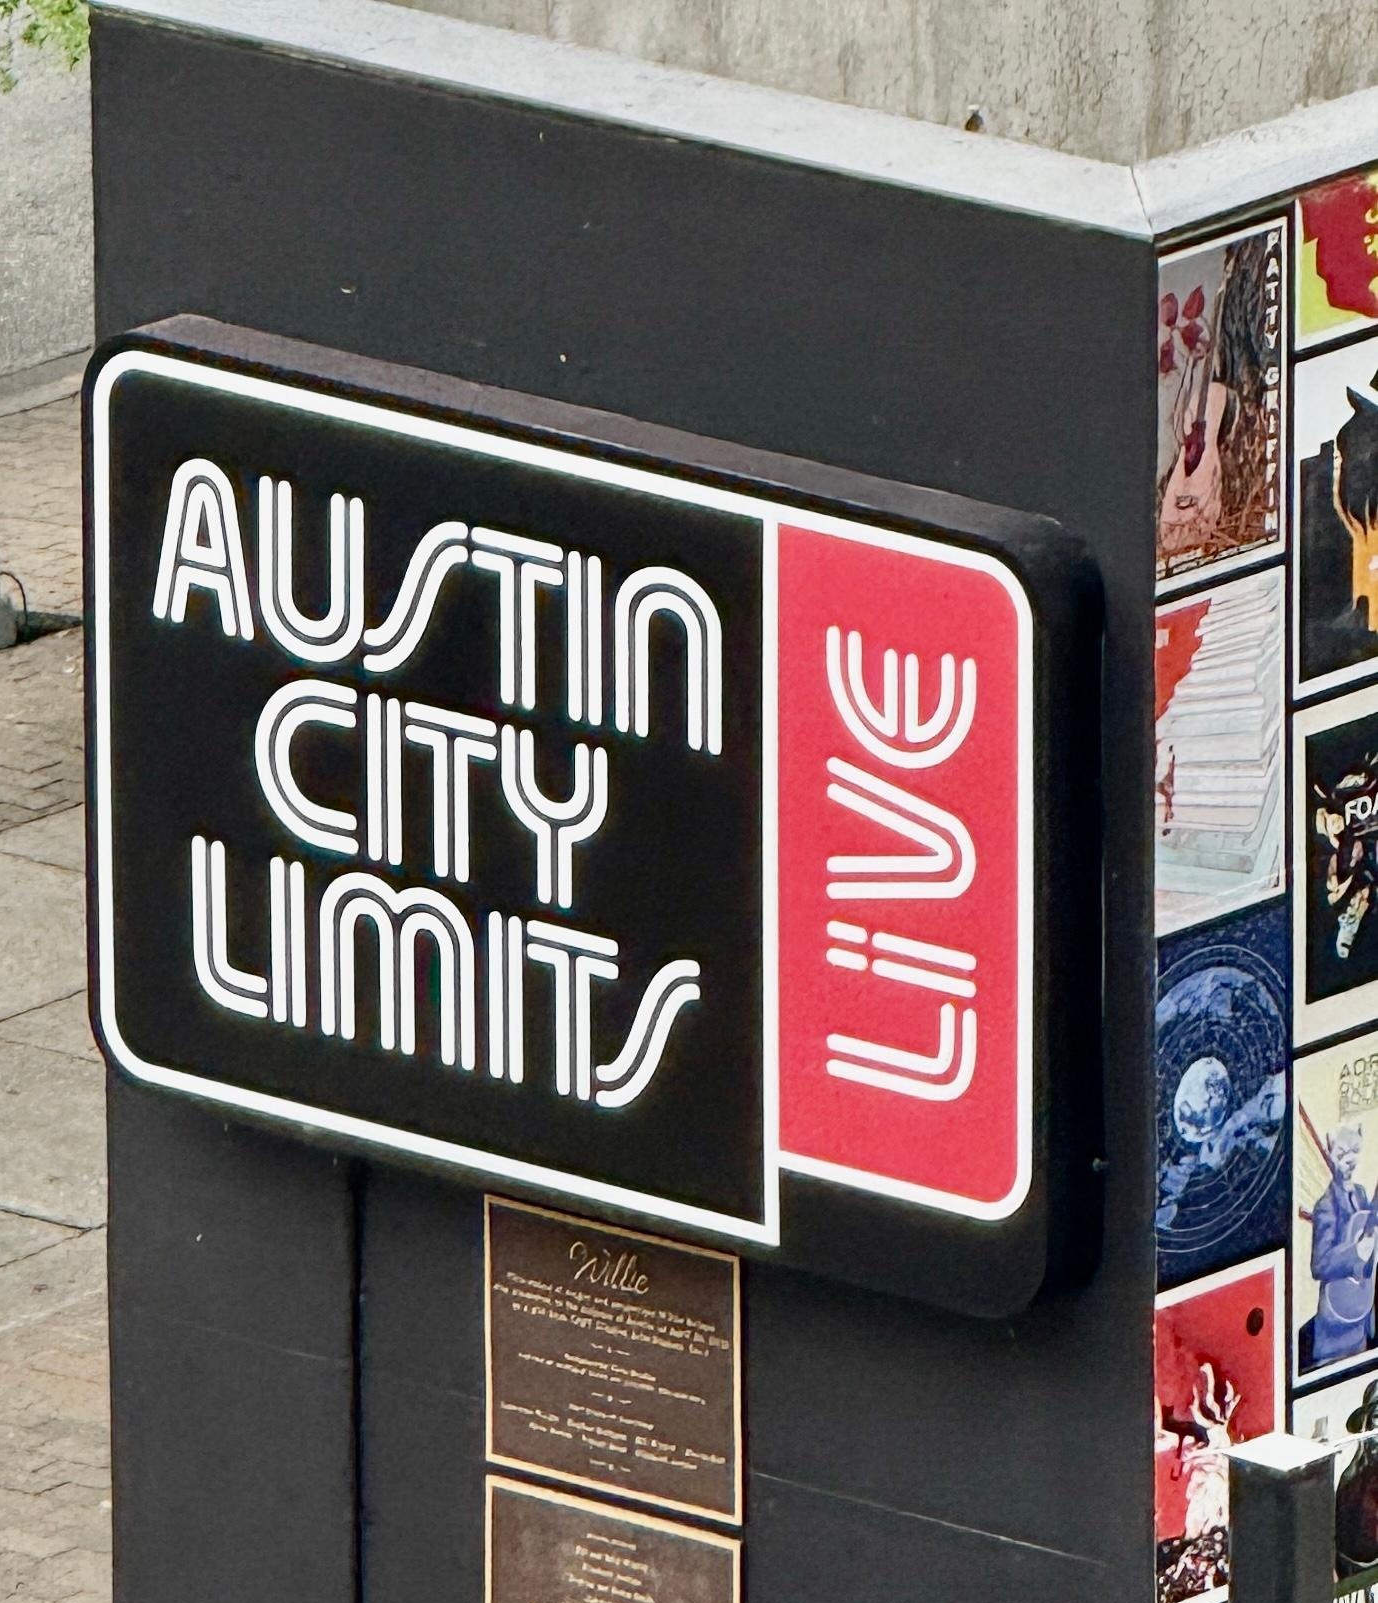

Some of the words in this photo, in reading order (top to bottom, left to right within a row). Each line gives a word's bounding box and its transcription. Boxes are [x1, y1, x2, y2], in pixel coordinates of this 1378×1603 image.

[1264, 230, 1281, 350] PATTY
[153, 457, 723, 756] AUSTIN
[254, 678, 608, 909] CITY
[191, 834, 701, 1108] LIMITS
[570, 1240, 650, 1295] Willie
